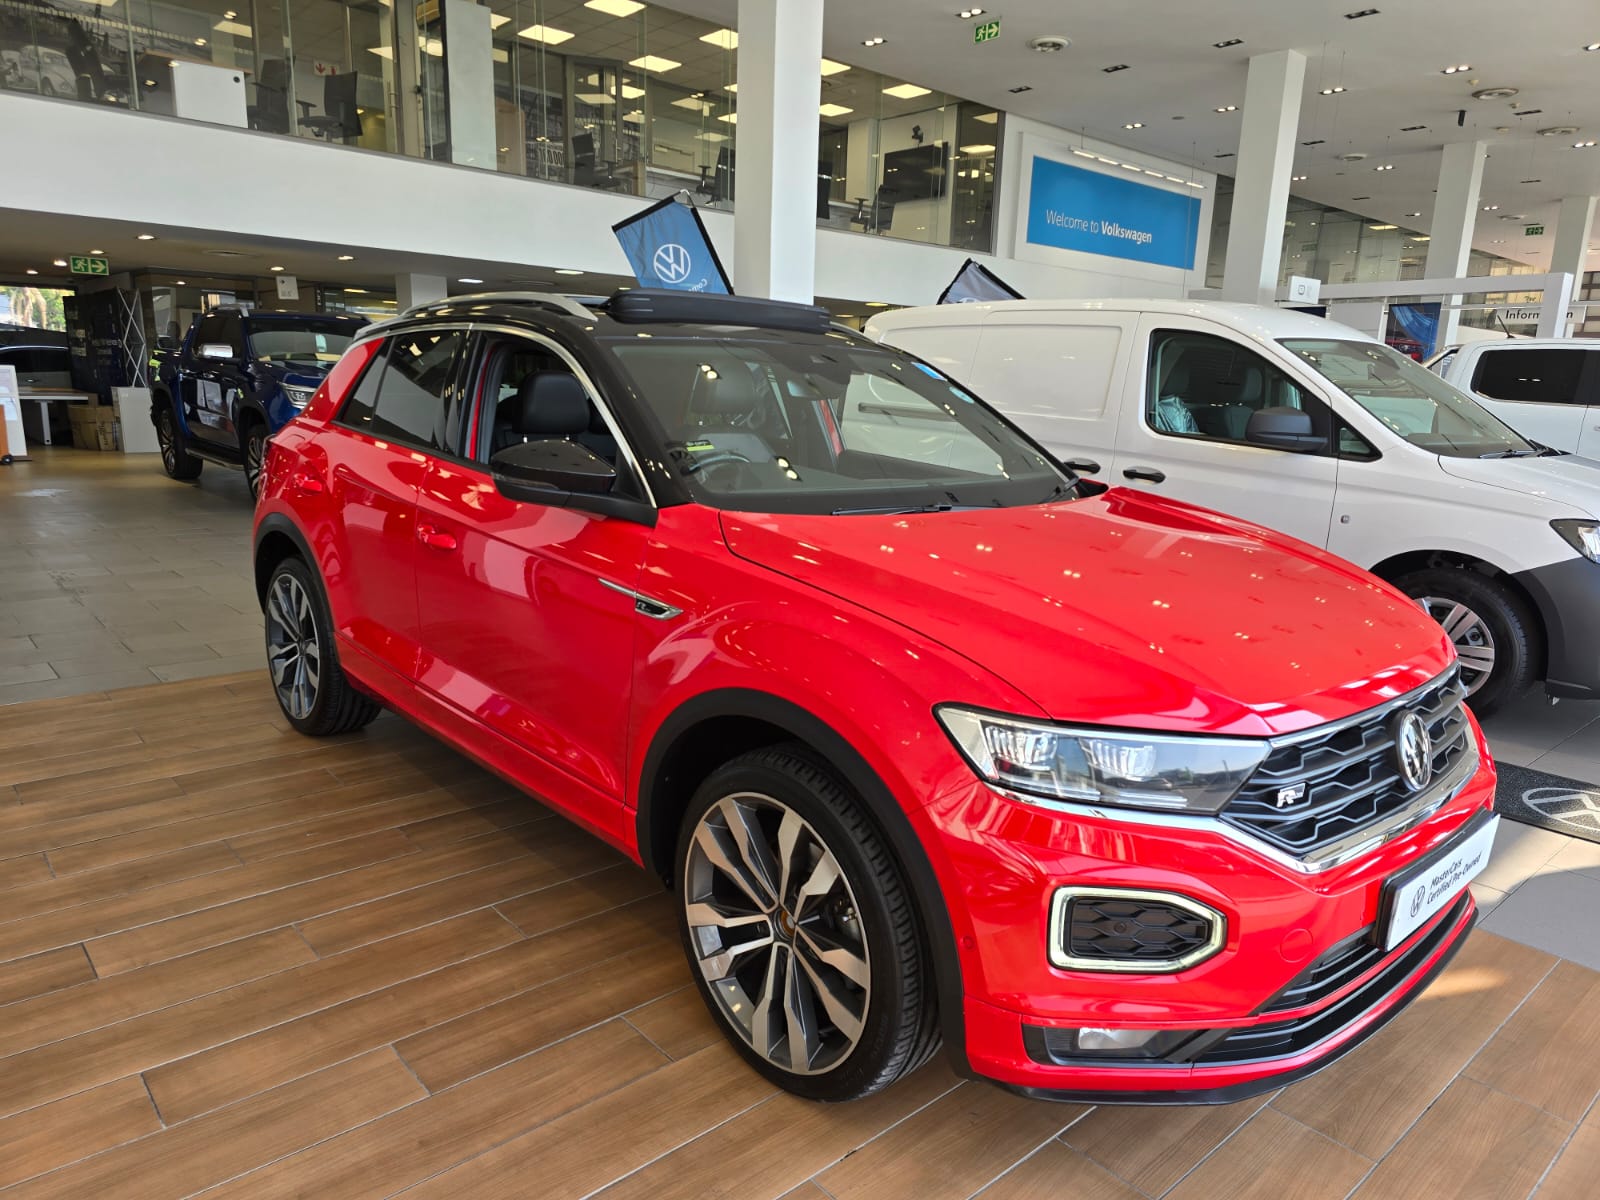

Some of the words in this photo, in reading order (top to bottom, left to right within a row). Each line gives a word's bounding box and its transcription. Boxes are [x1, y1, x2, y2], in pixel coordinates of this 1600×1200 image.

[1046, 209, 1088, 232] Welcome
[1090, 221, 1099, 234] to
[1101, 220, 1153, 245] Volkswagen
[1427, 877, 1453, 905] Certified
